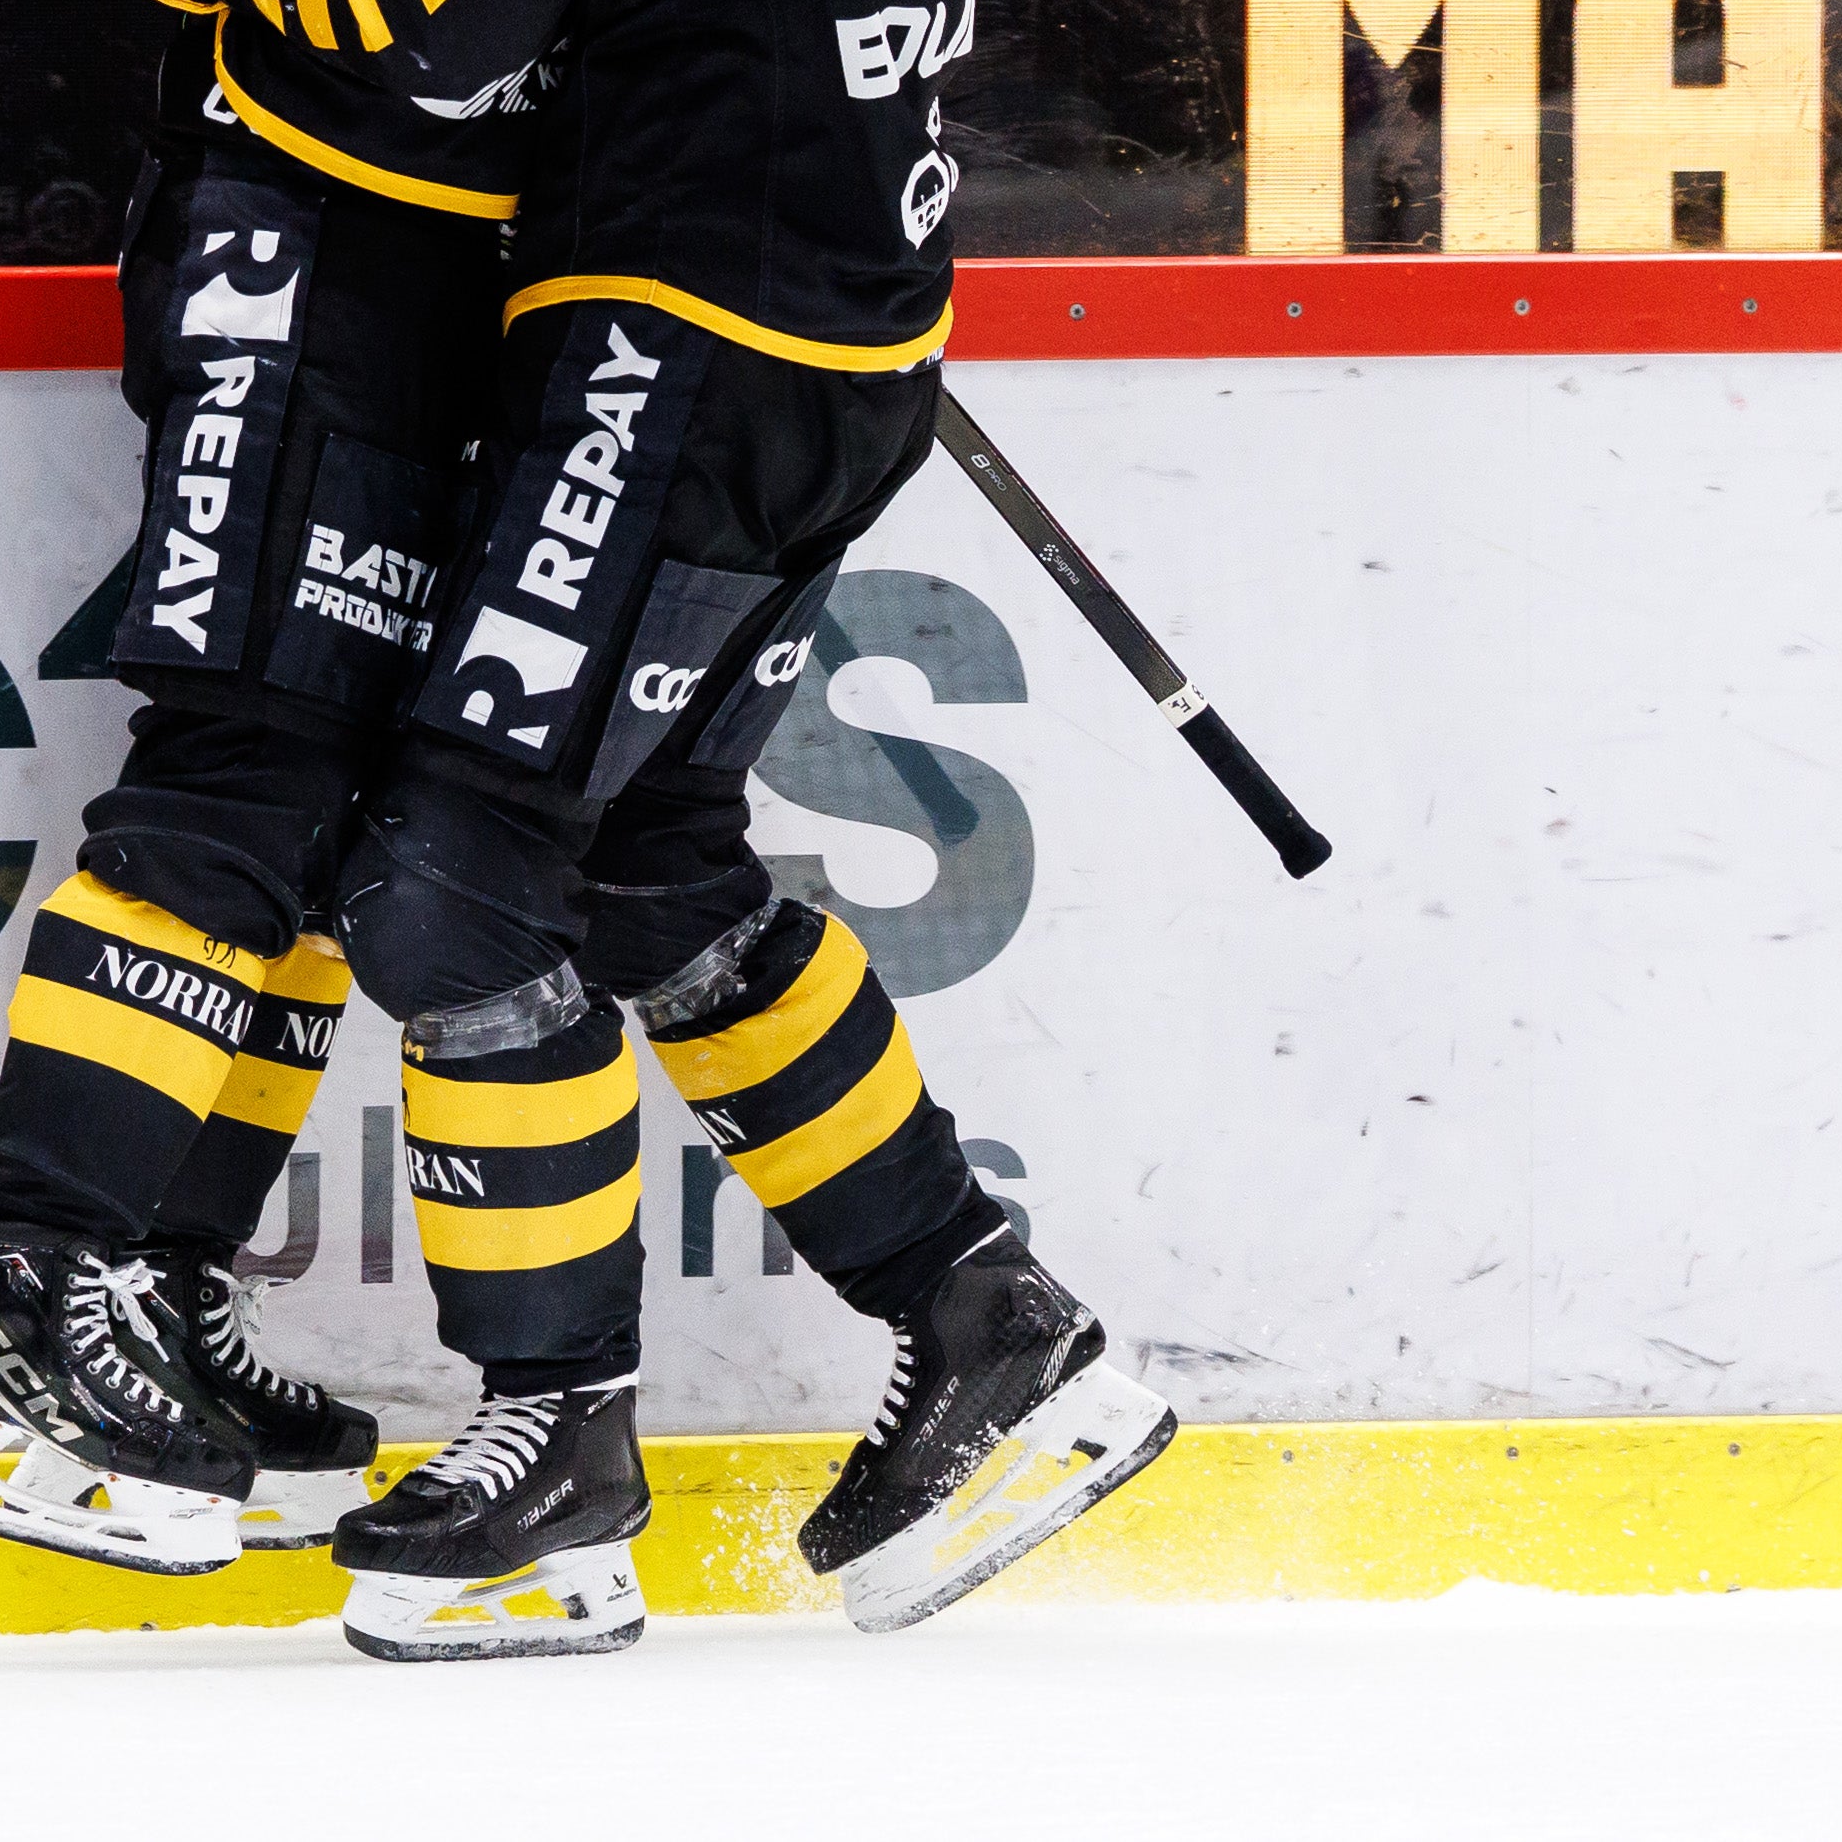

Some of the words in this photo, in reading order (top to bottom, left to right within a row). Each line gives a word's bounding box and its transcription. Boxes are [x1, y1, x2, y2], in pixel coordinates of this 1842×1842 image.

[152, 355, 256, 655] REPAY
[516, 322, 661, 611] REPAY
[1053, 555, 1081, 586] sigma
